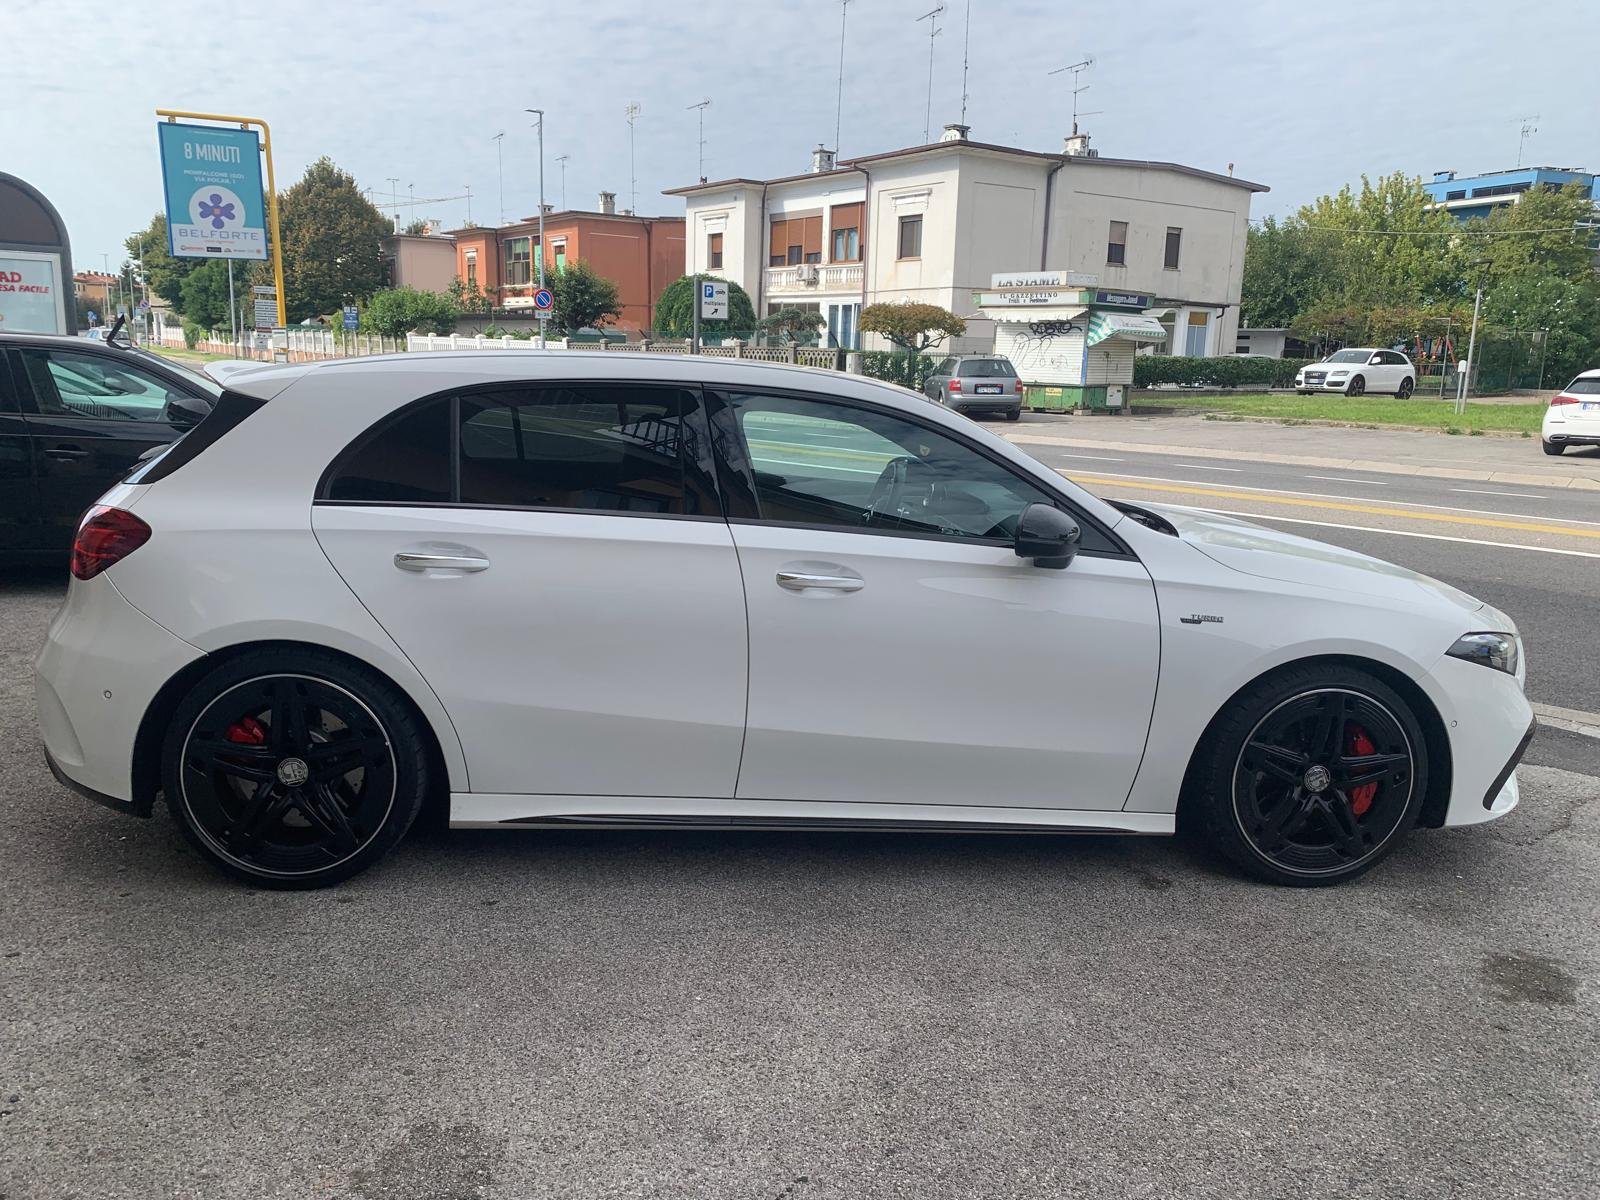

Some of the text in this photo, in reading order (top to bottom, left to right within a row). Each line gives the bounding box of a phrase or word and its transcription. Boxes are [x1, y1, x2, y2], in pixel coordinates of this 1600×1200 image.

[184, 142, 240, 163] 8 MINUTI
[178, 228, 259, 241] BELFORTE
[18, 285, 50, 294] FACILE
[706, 286, 713, 296] P
